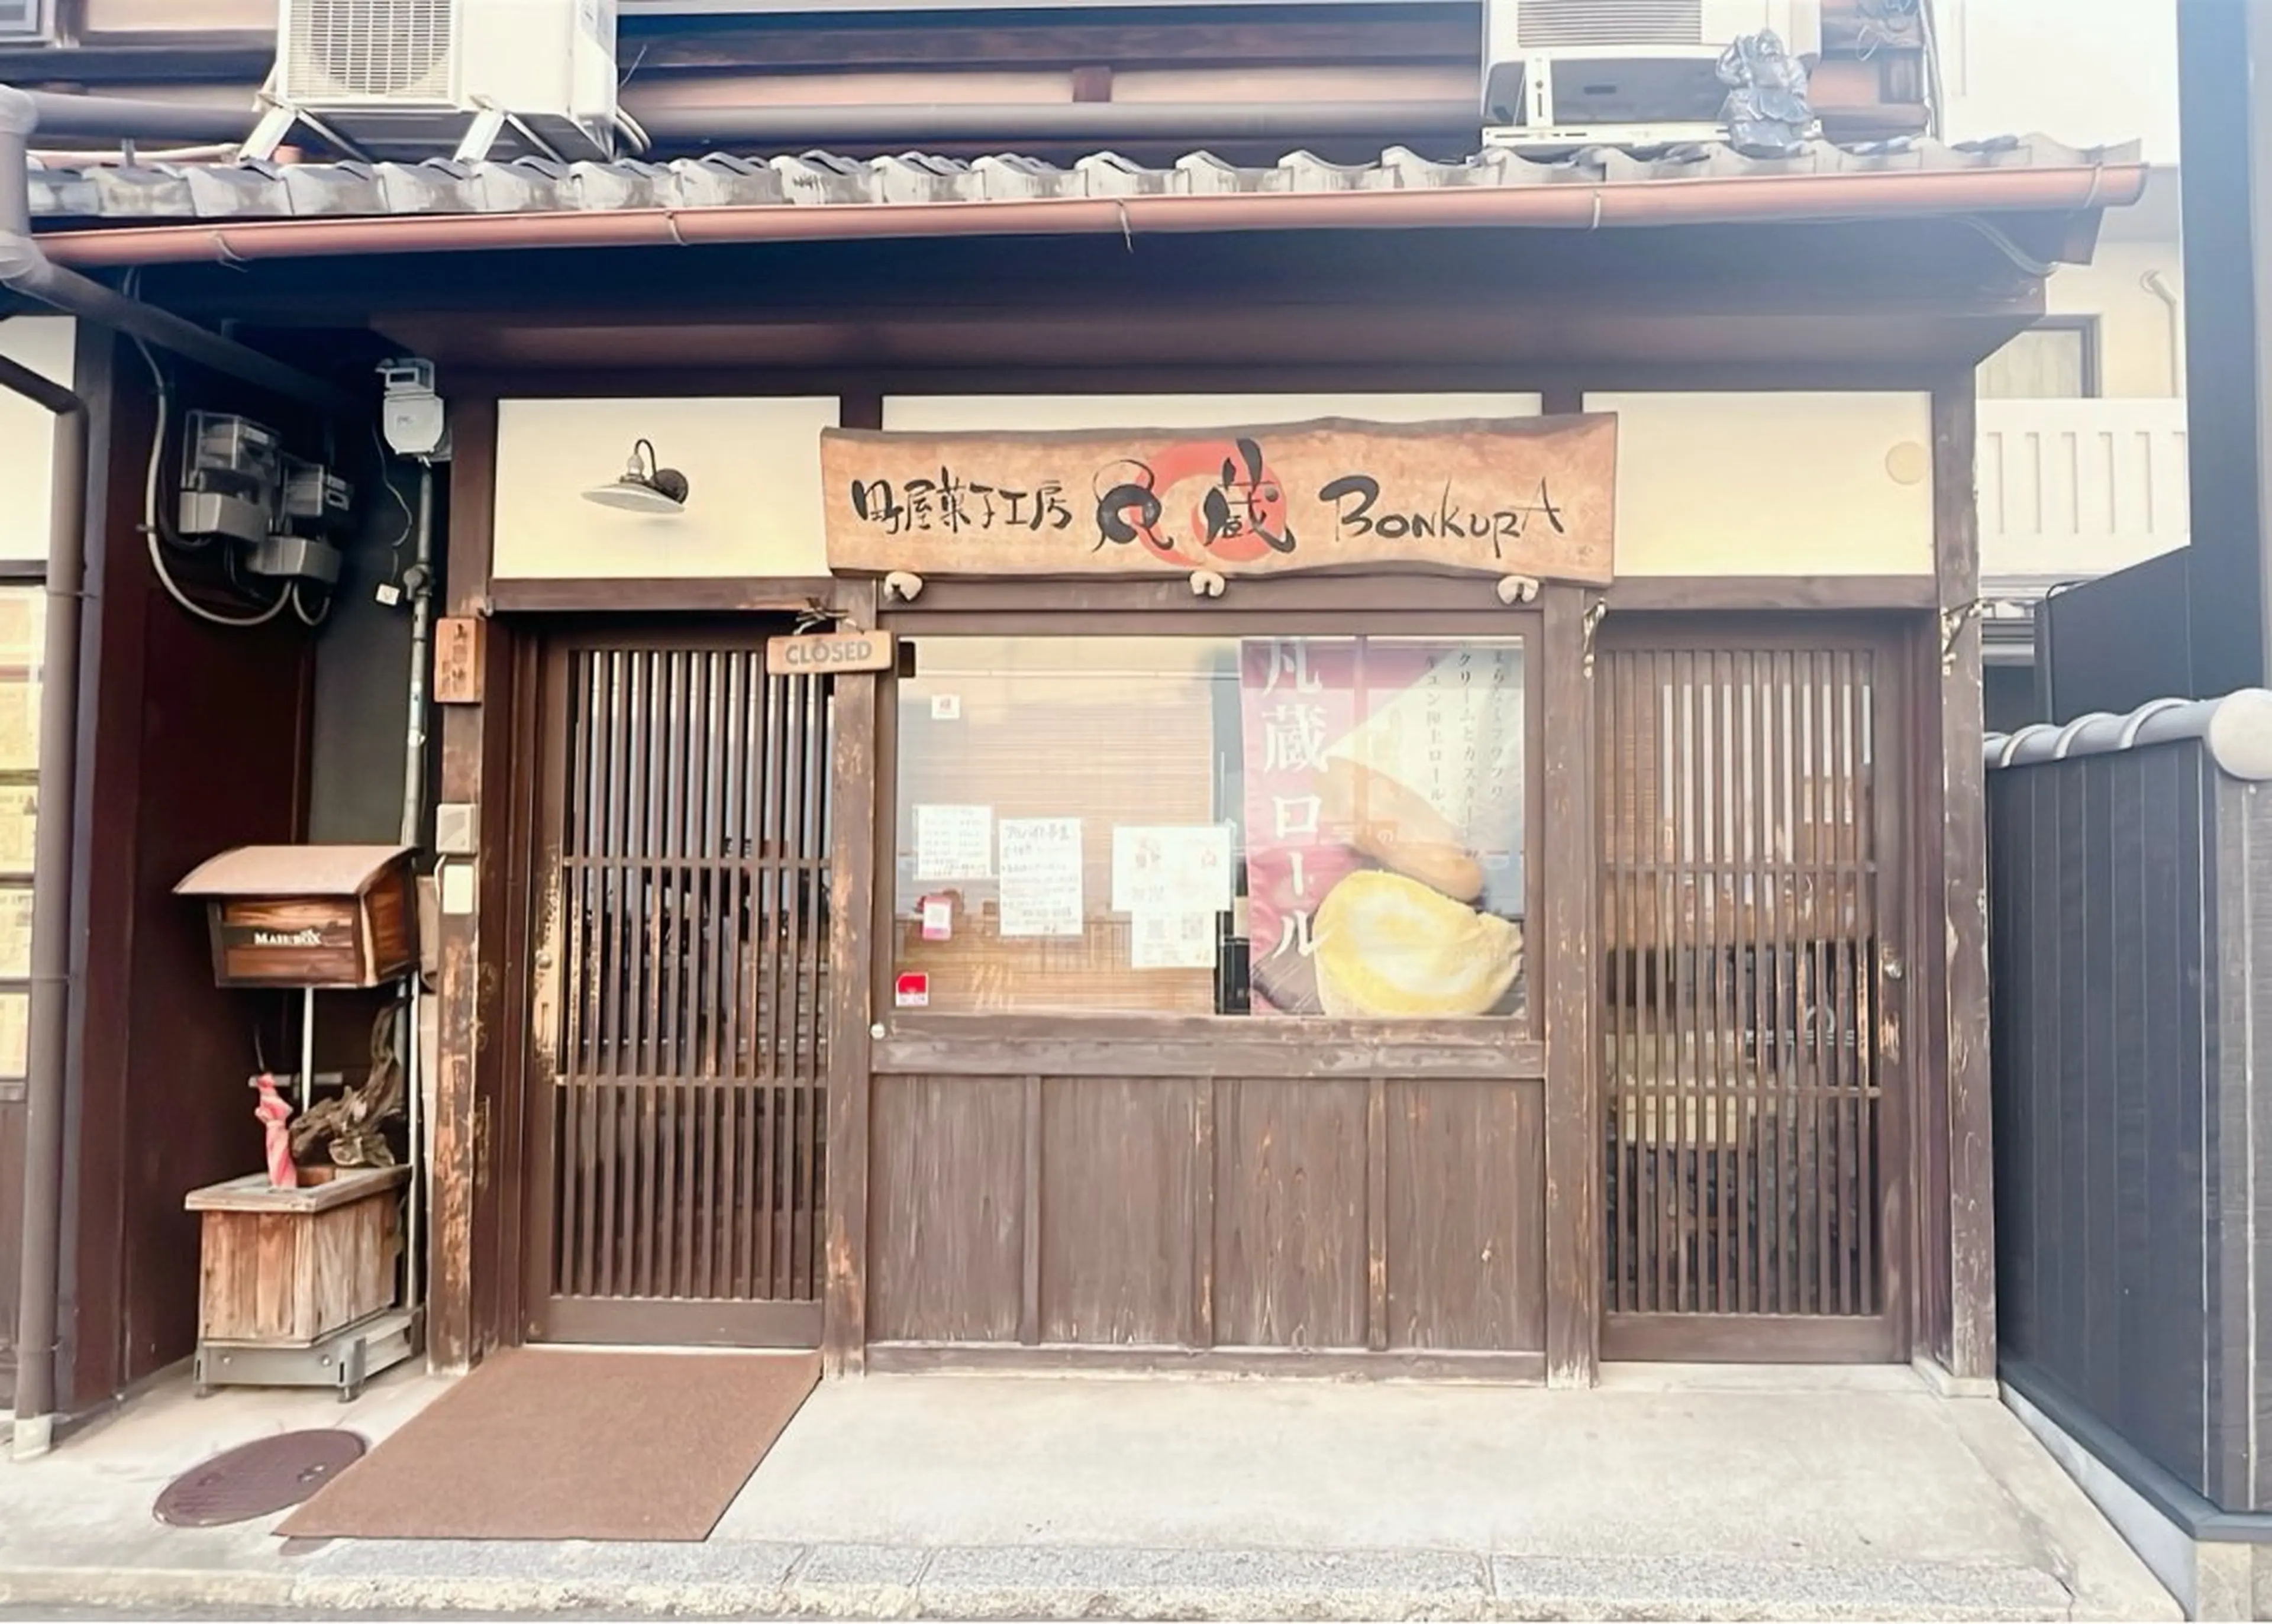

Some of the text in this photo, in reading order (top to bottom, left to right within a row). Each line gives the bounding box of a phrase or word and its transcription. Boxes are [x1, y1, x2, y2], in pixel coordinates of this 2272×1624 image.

[851, 465, 1072, 534] 町屋菓子工房
[786, 640, 873, 665] CLOSED
[1262, 637, 1332, 960] 凡蔵ロール
